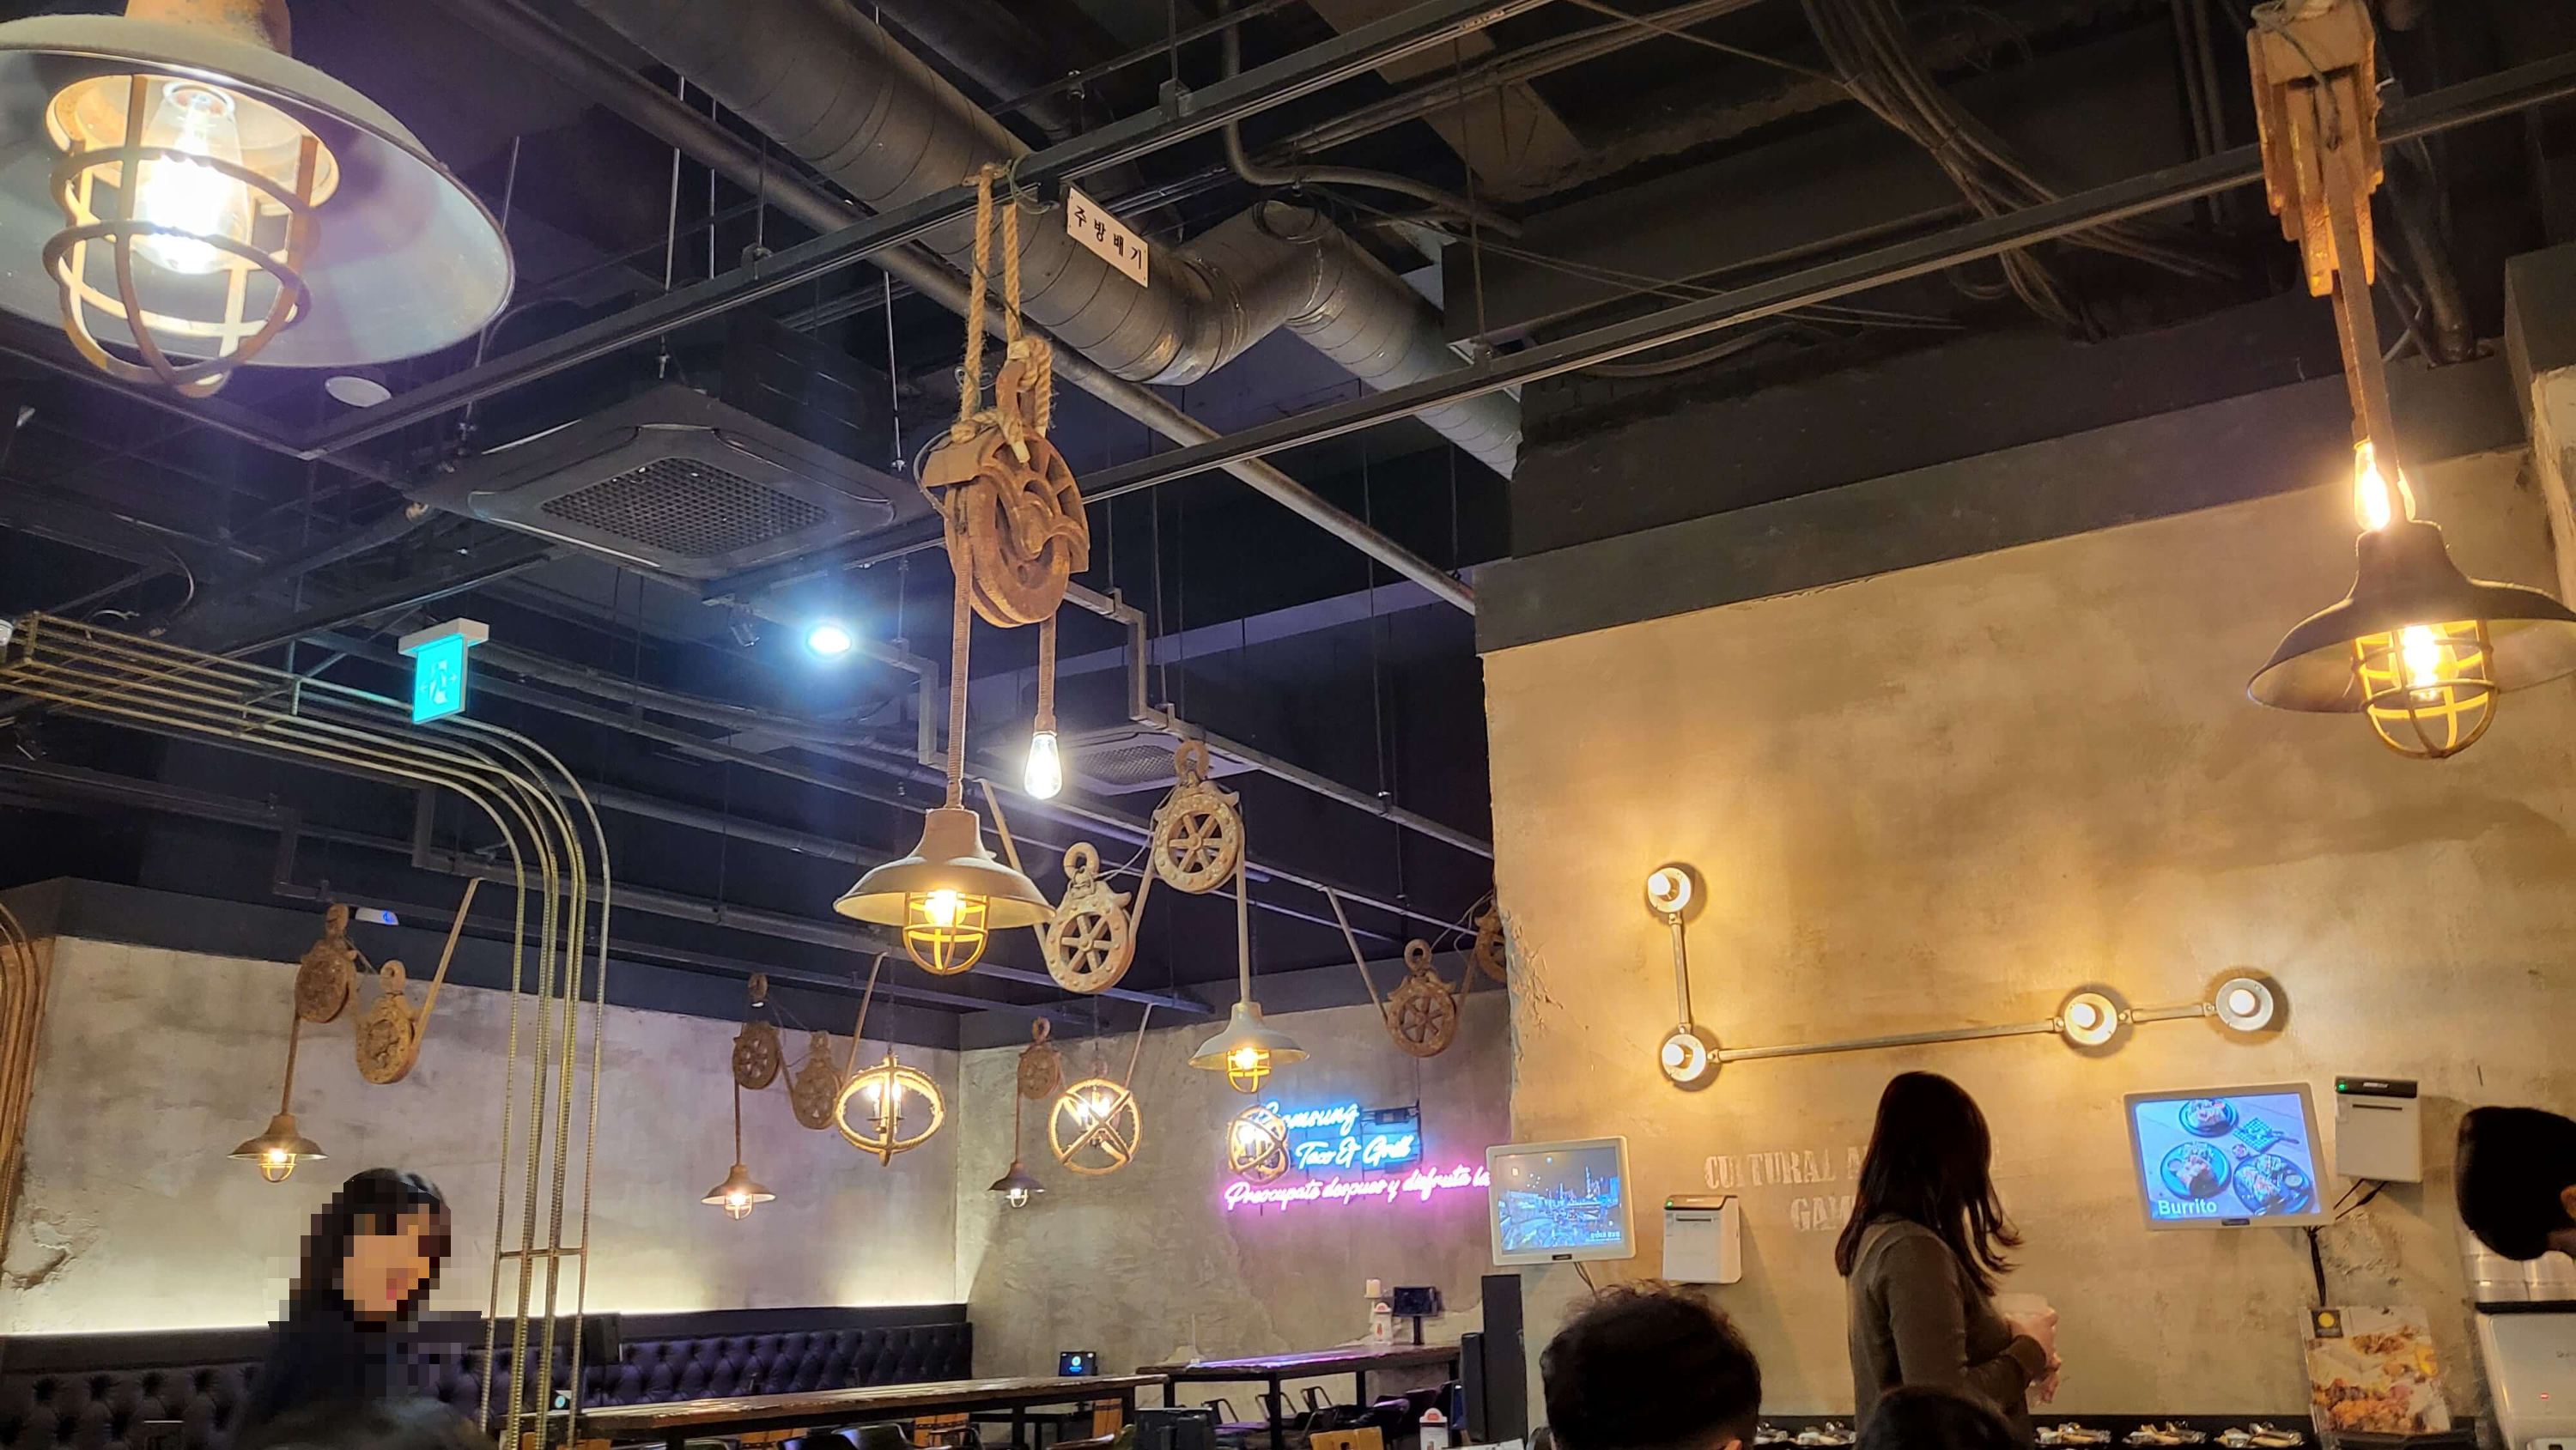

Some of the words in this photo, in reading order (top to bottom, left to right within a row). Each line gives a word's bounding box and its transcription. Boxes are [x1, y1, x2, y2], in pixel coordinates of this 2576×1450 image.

[1074, 205, 1142, 270] 주방배기
[1295, 1141, 1337, 1170] Taco
[1704, 1149, 1837, 1190] CULTURAL
[2157, 1198, 2217, 1216] Burrito
